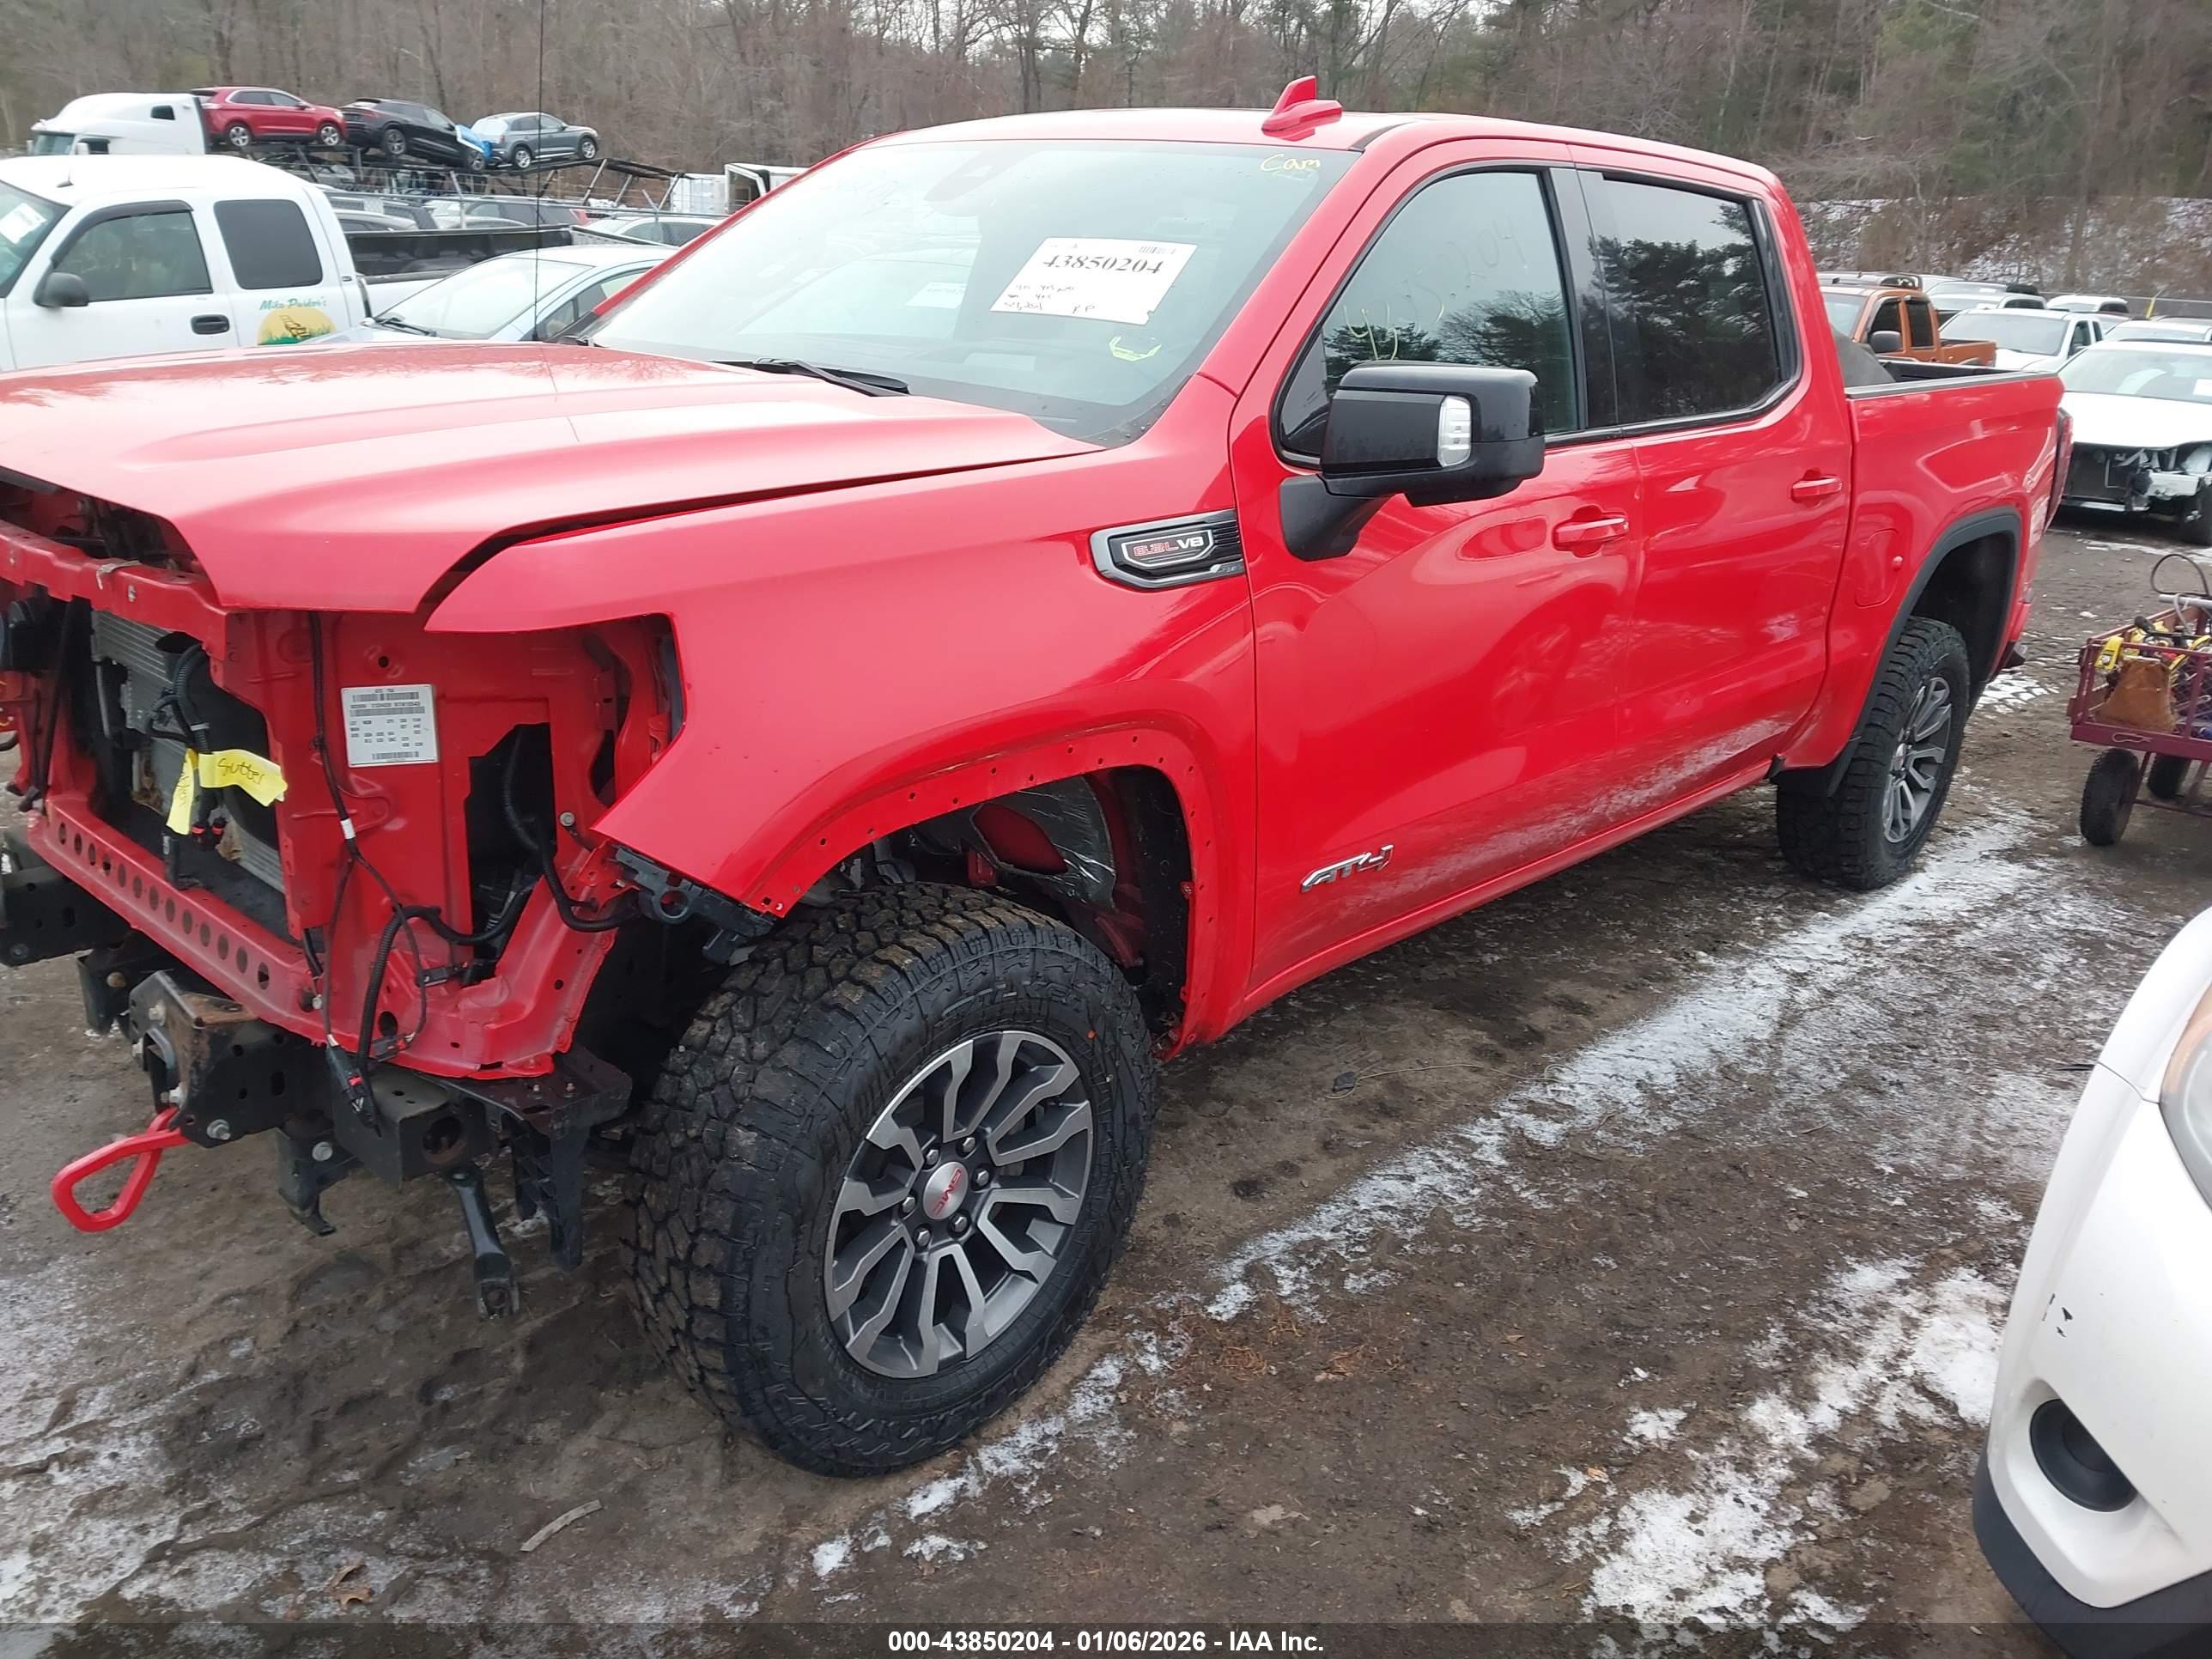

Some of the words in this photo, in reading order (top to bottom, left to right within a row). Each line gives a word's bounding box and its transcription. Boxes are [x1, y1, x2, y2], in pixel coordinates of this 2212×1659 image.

[1042, 253, 1165, 275] 43850204
[1299, 844, 1395, 894] AT4
[933, 1167, 963, 1217] GMC
